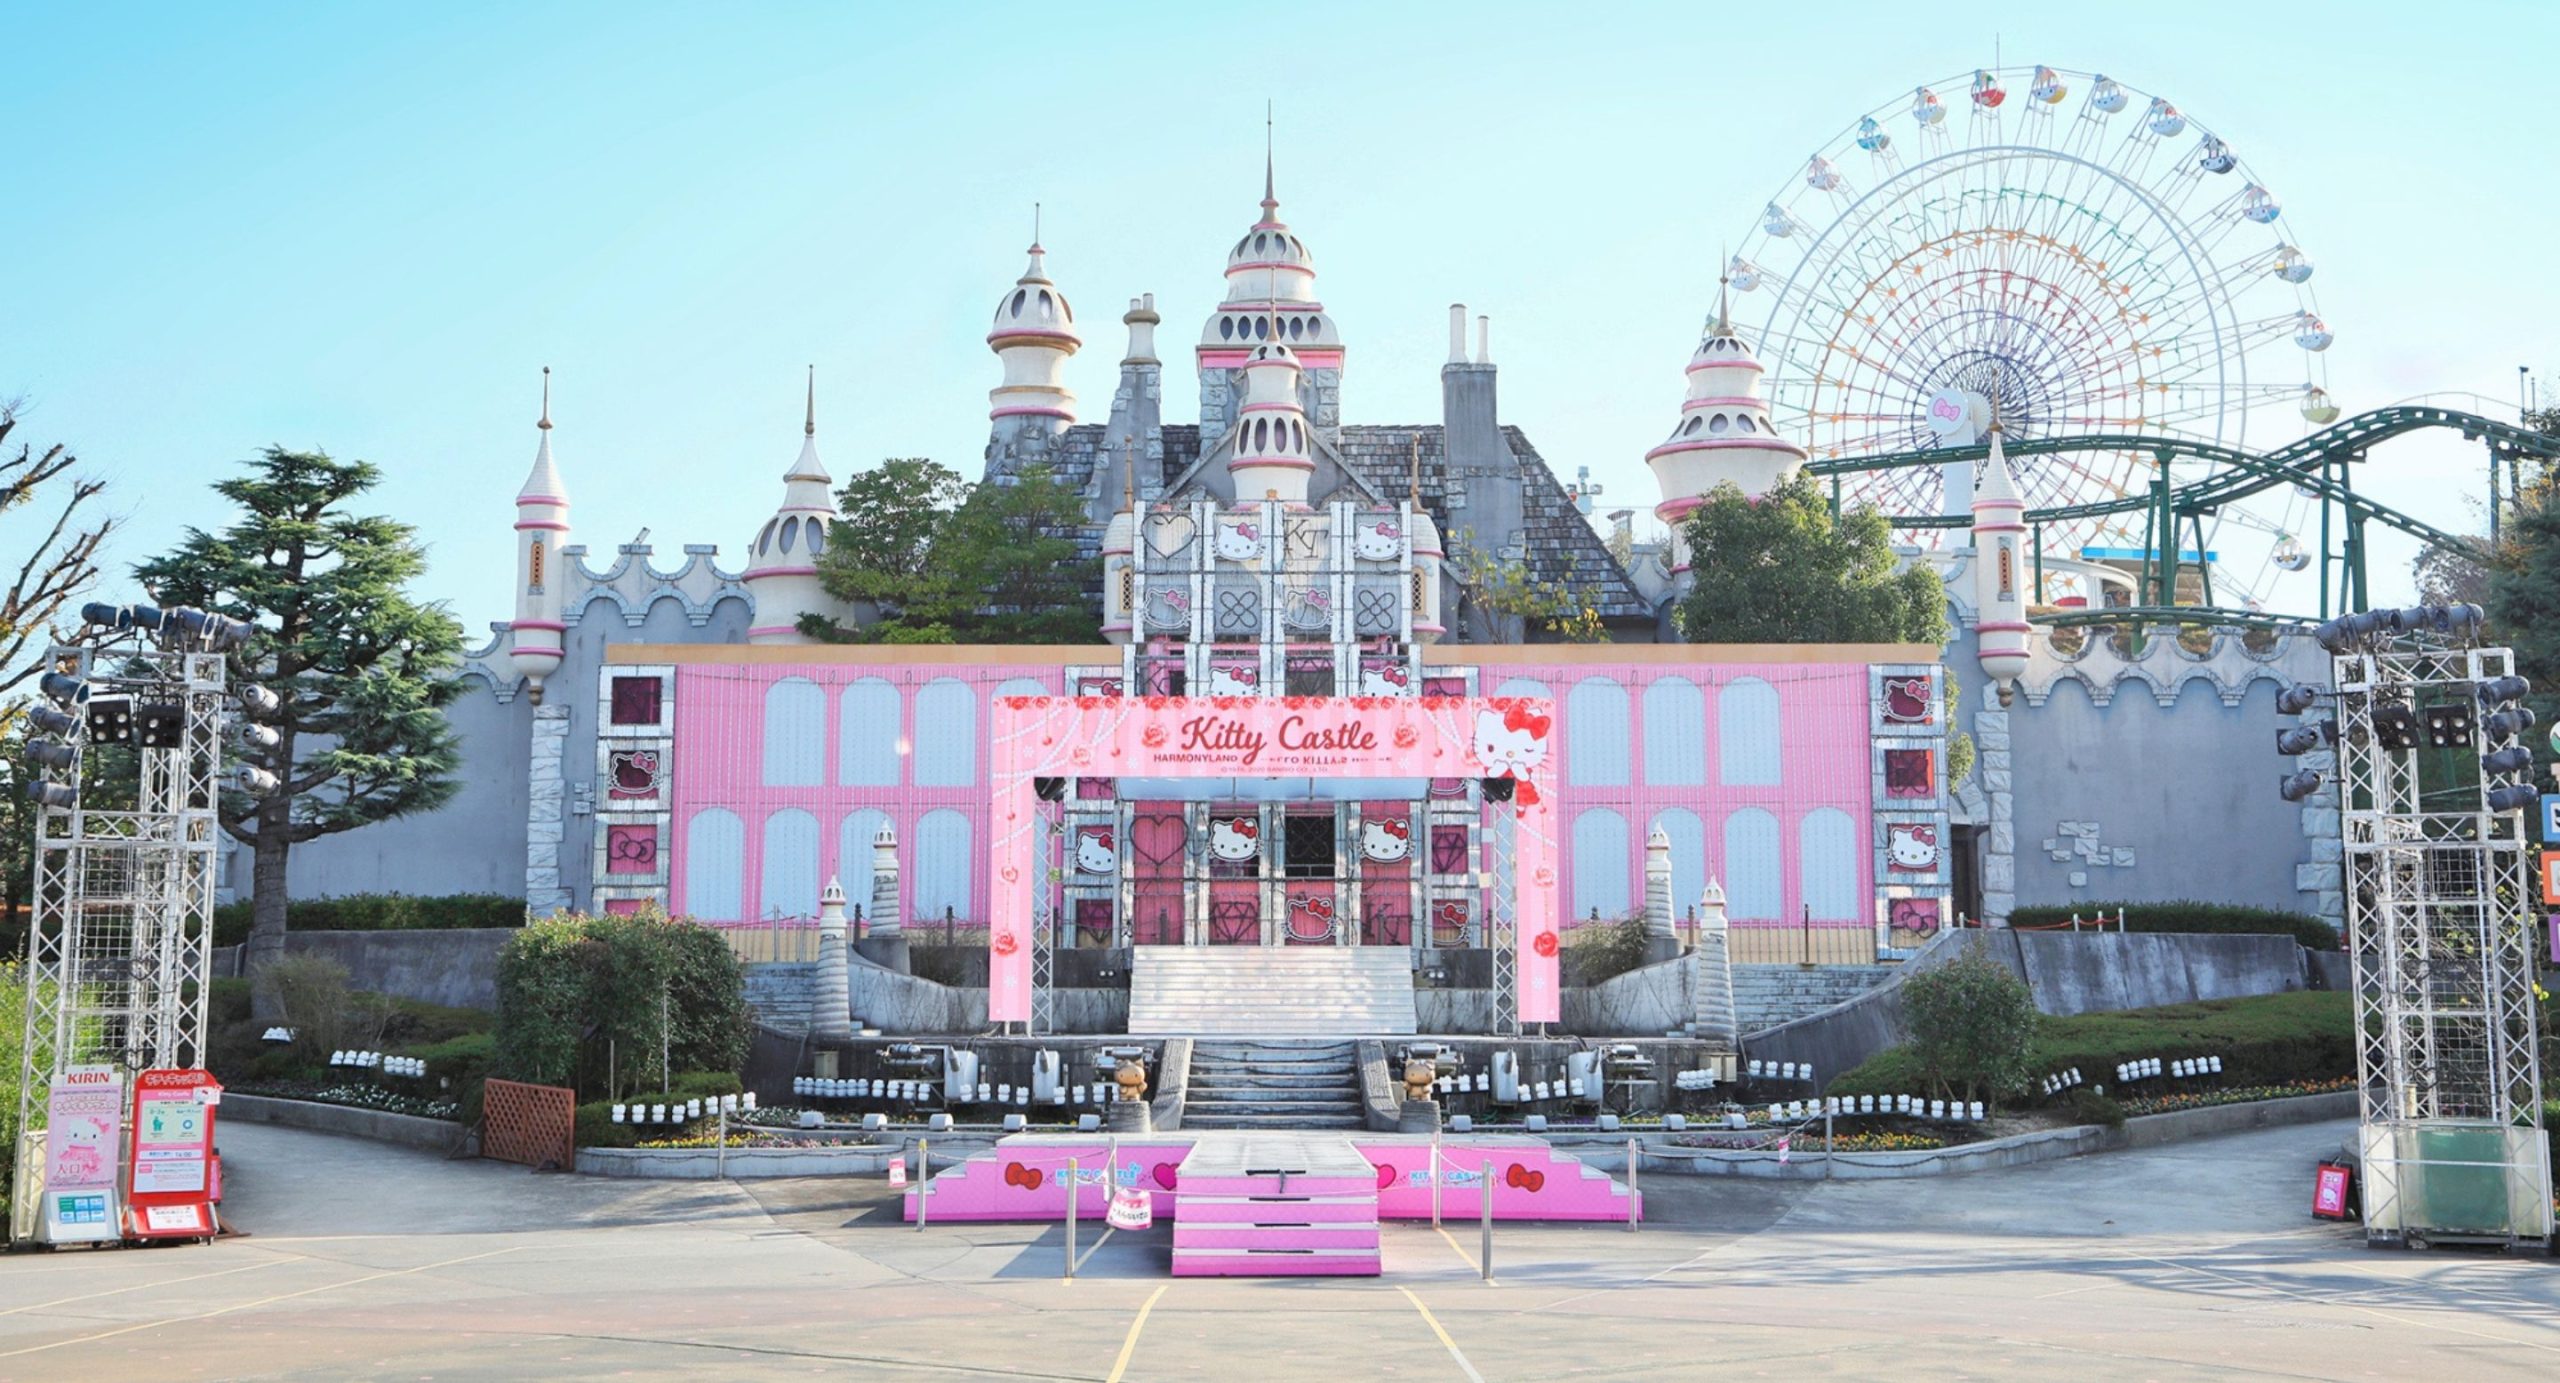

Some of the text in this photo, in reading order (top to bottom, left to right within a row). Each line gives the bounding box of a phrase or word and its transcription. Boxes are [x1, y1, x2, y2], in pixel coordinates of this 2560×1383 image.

[1181, 715, 1378, 765] Kitty Castle
[1153, 754, 1238, 762] HARMONYLAND
[68, 1072, 110, 1084] KIRIN
